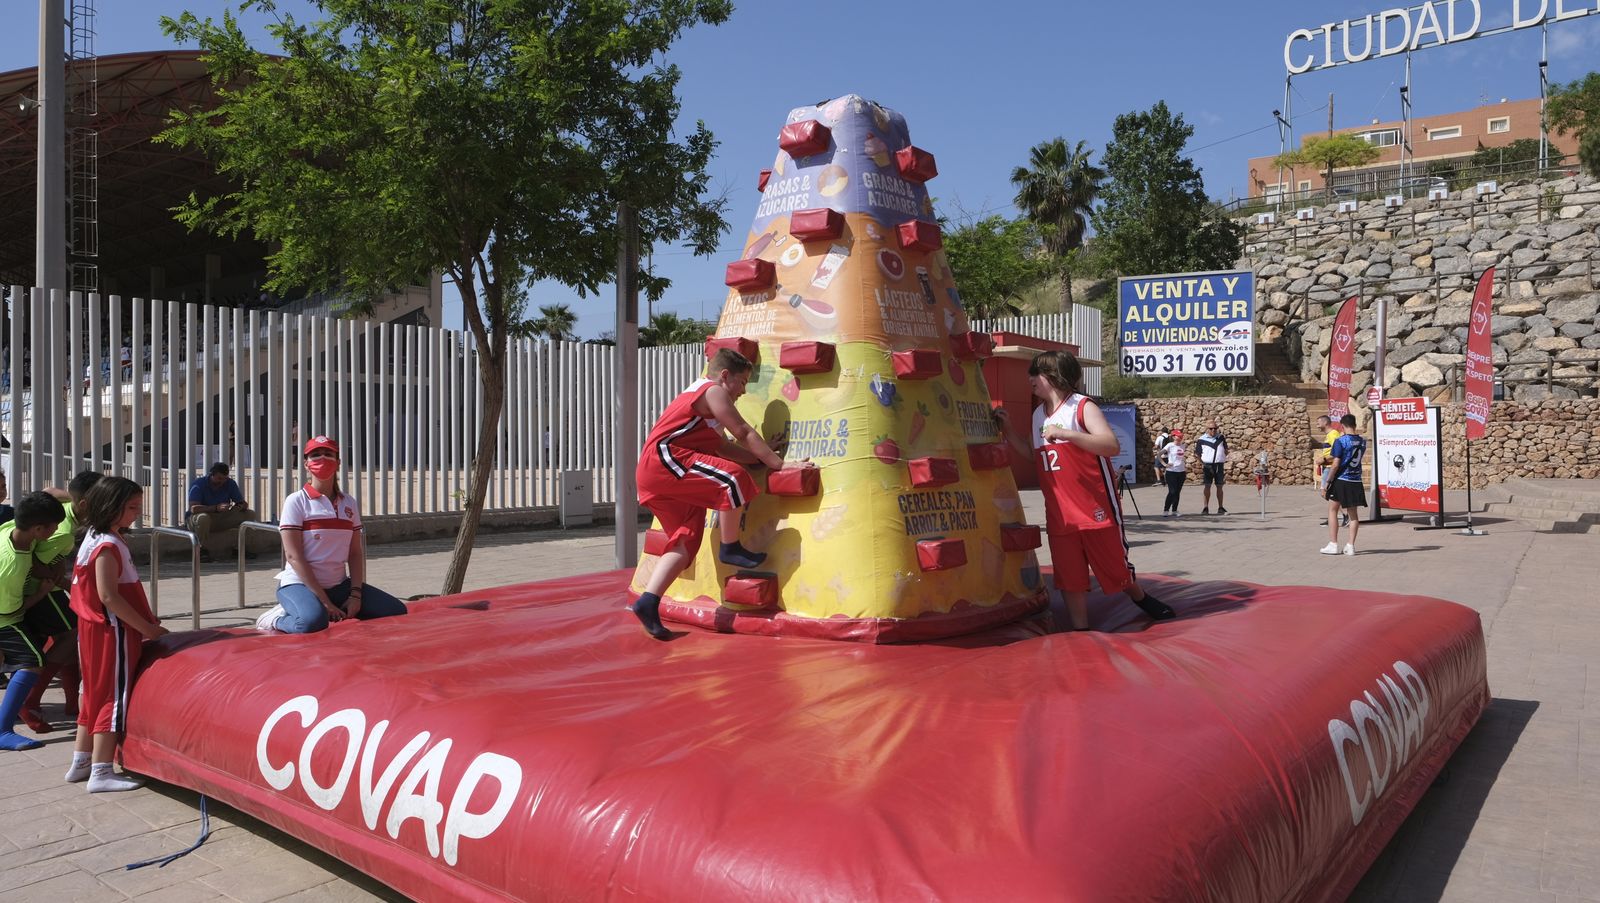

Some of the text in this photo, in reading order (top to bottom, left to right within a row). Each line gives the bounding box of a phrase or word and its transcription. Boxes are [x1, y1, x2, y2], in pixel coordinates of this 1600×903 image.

[1284, 0, 1482, 73] CIUDAD
[862, 172, 905, 197] GRASAS
[755, 193, 809, 219] AZUCARES
[868, 191, 919, 216] AZUCARES
[875, 284, 924, 311] LÁCTEOS
[1134, 277, 1239, 300] VENTA Y
[725, 311, 766, 325] ALIMENTOS
[766, 309, 777, 322] DE
[889, 308, 926, 324] ALIMENTOS
[926, 312, 937, 325] DE
[1125, 300, 1248, 326] ALQUILER
[744, 321, 776, 337] ANIMAL
[882, 320, 913, 337] ORIGEN
[1124, 326, 1218, 343] DE VIVIENDAS
[1201, 344, 1249, 352] www.zoi.es
[1123, 352, 1248, 373] 950 31 76 00
[955, 400, 988, 420] FRUTAS
[1381, 401, 1416, 413] SIÉNTETE
[1403, 412, 1425, 421] ELLOS
[784, 418, 849, 440] FRUTAS &
[1379, 438, 1437, 449] #SiempreConRespeto
[1040, 450, 1061, 471] 12
[1349, 447, 1362, 468] 9
[898, 490, 976, 514] CEREALES, PAN
[904, 510, 979, 536] ARROZ & PASTA
[1328, 660, 1429, 826] COVAP
[257, 695, 522, 866] COVAP
